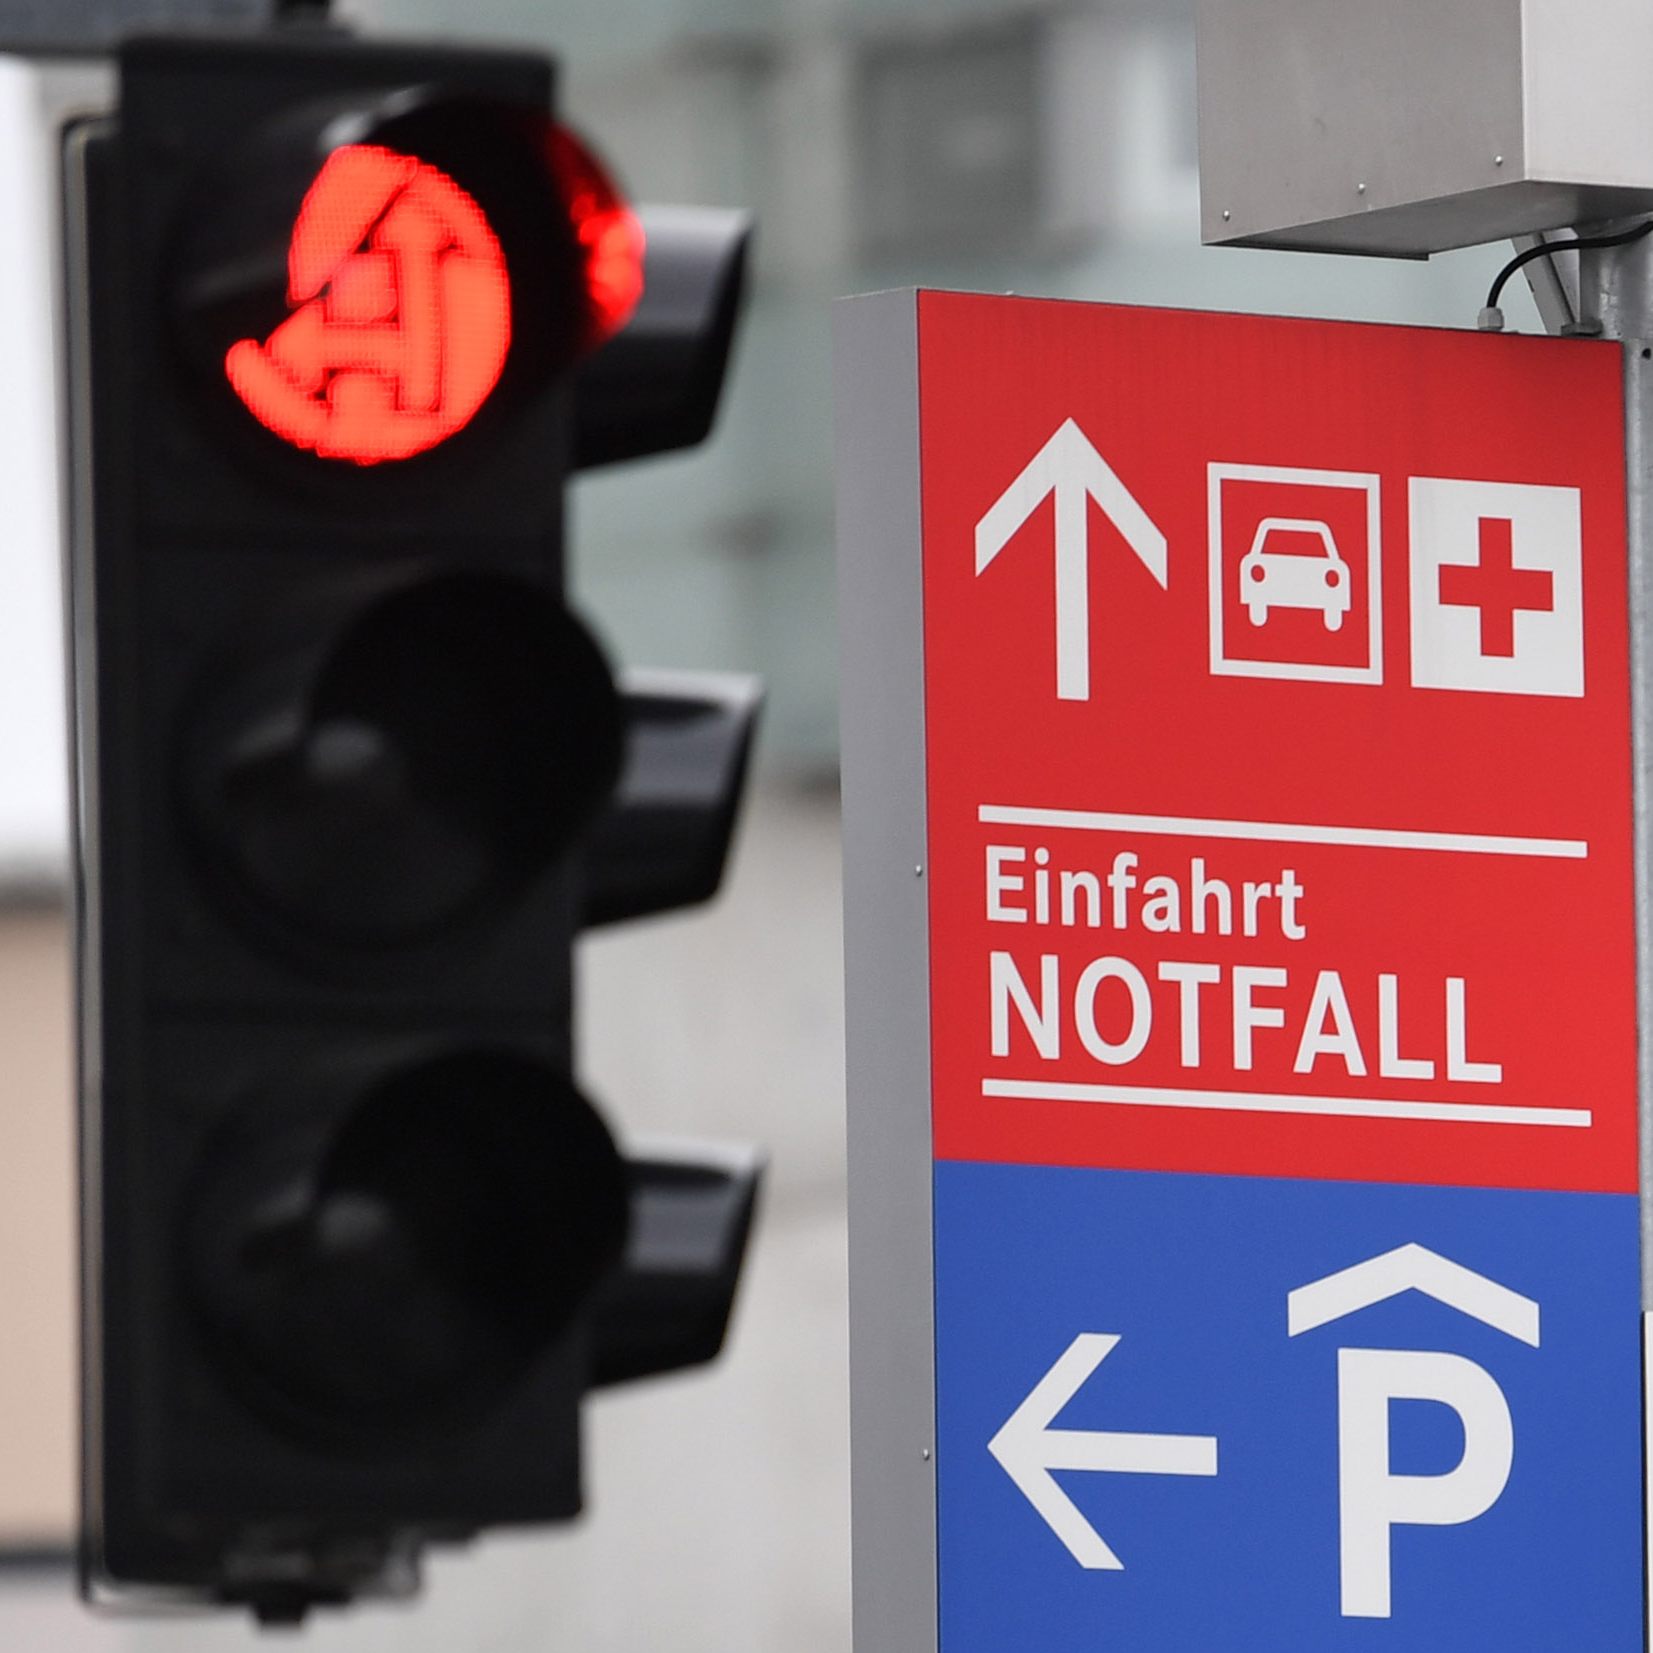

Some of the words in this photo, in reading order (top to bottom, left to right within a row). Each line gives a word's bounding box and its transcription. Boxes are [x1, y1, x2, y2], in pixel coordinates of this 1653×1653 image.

[986, 845, 1306, 940] Einfahrt
[990, 951, 1502, 1083] NOTFALL
[1337, 1347, 1514, 1618] P
